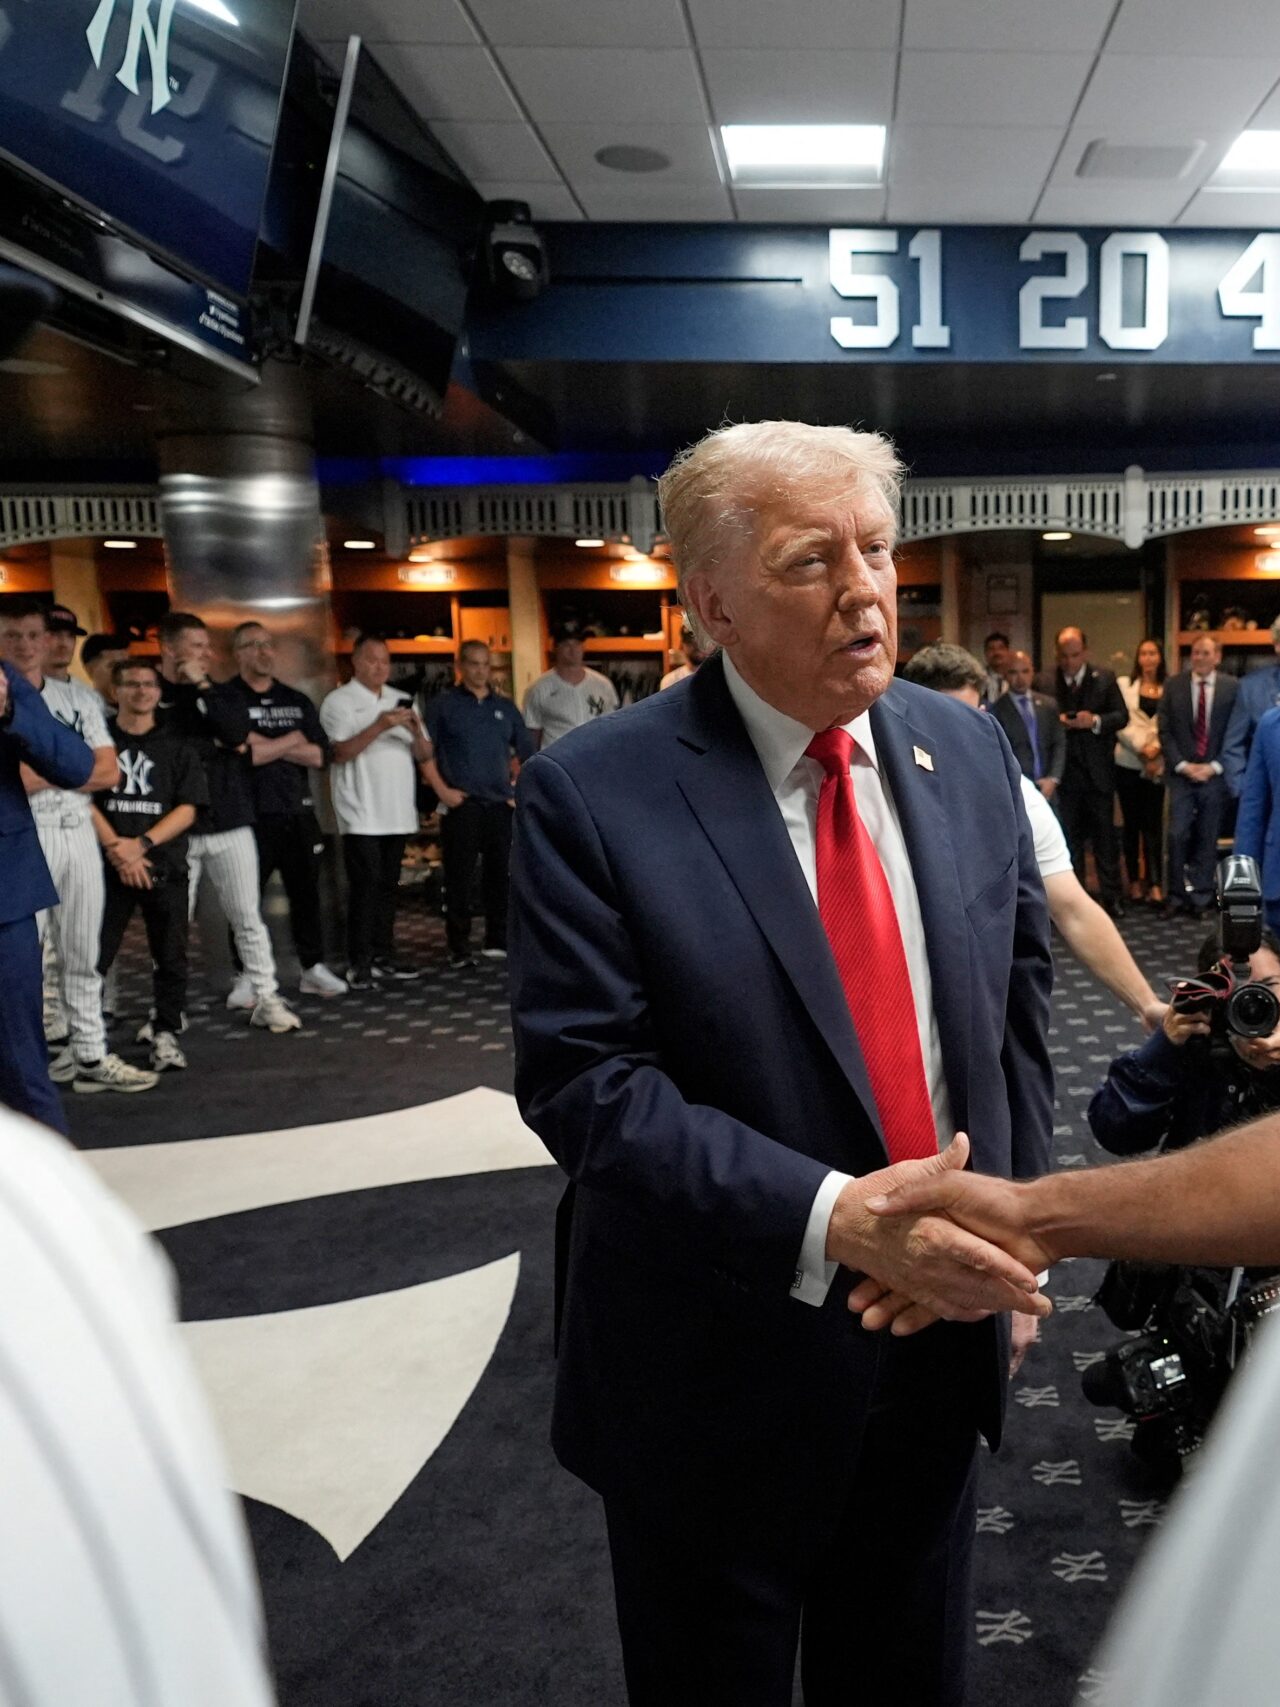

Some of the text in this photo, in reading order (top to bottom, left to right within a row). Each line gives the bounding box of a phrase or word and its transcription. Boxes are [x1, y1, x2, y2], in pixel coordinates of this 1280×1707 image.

[829, 229, 950, 347] 51
[1019, 231, 1170, 349] 20
[117, 800, 162, 815] YANKEES
[1052, 1551, 1108, 1583] NY
[976, 1609, 1033, 1645] NY
